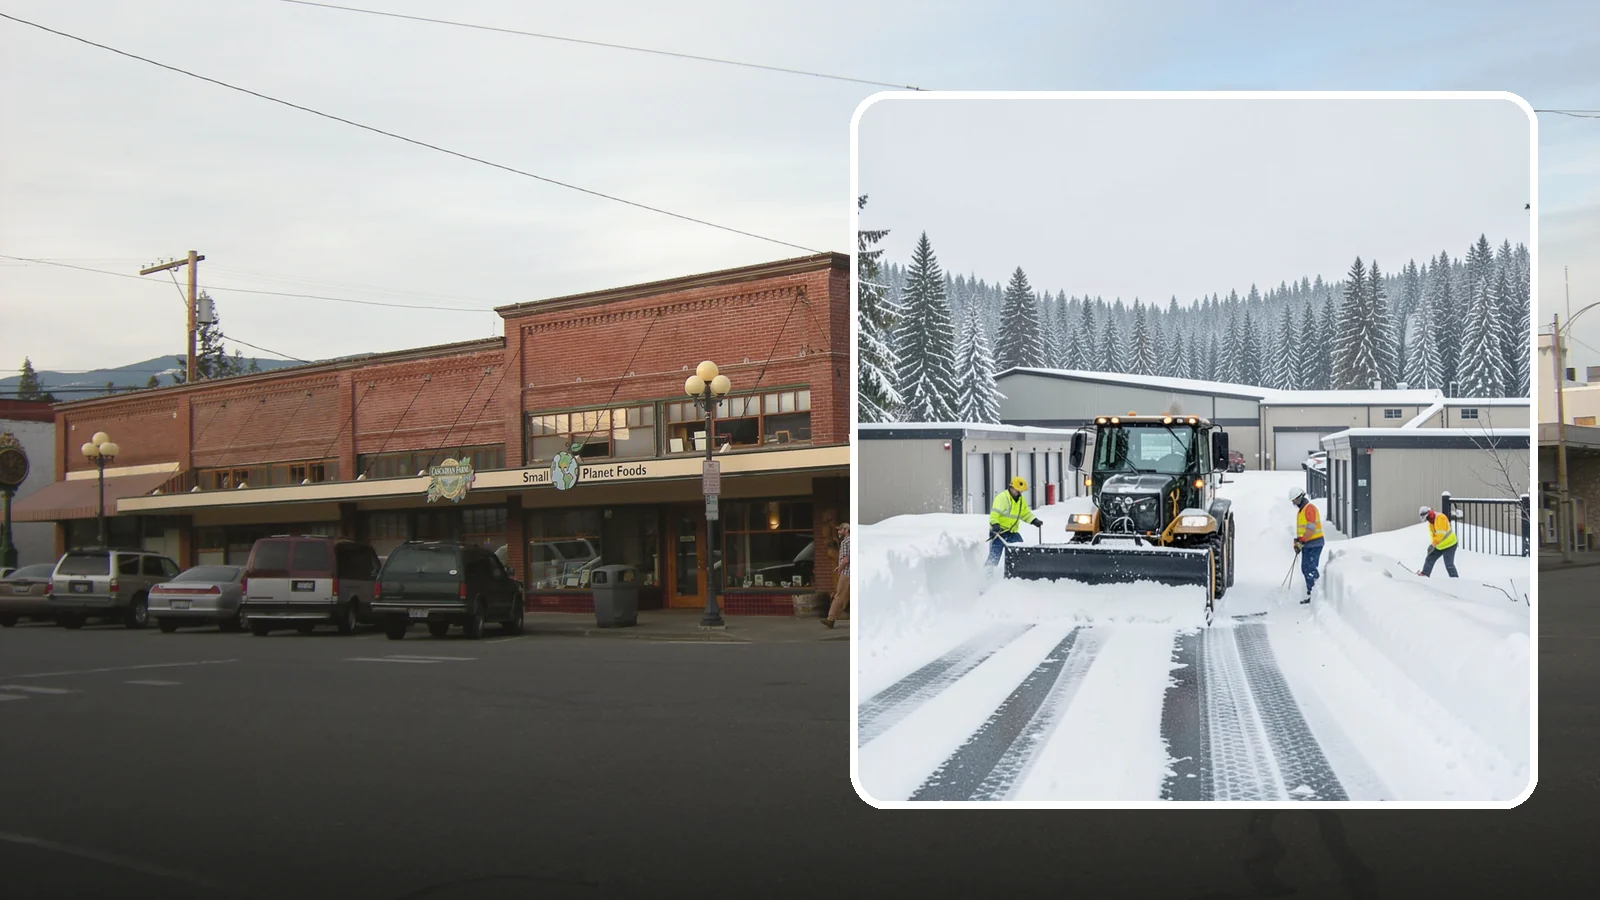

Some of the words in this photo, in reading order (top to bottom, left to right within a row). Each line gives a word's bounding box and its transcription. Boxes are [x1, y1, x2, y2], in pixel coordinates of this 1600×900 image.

[432, 467, 456, 475] CASCADIAN
[523, 470, 549, 483] Small
[582, 467, 614, 479] Planet
[616, 464, 647, 477] Foods
